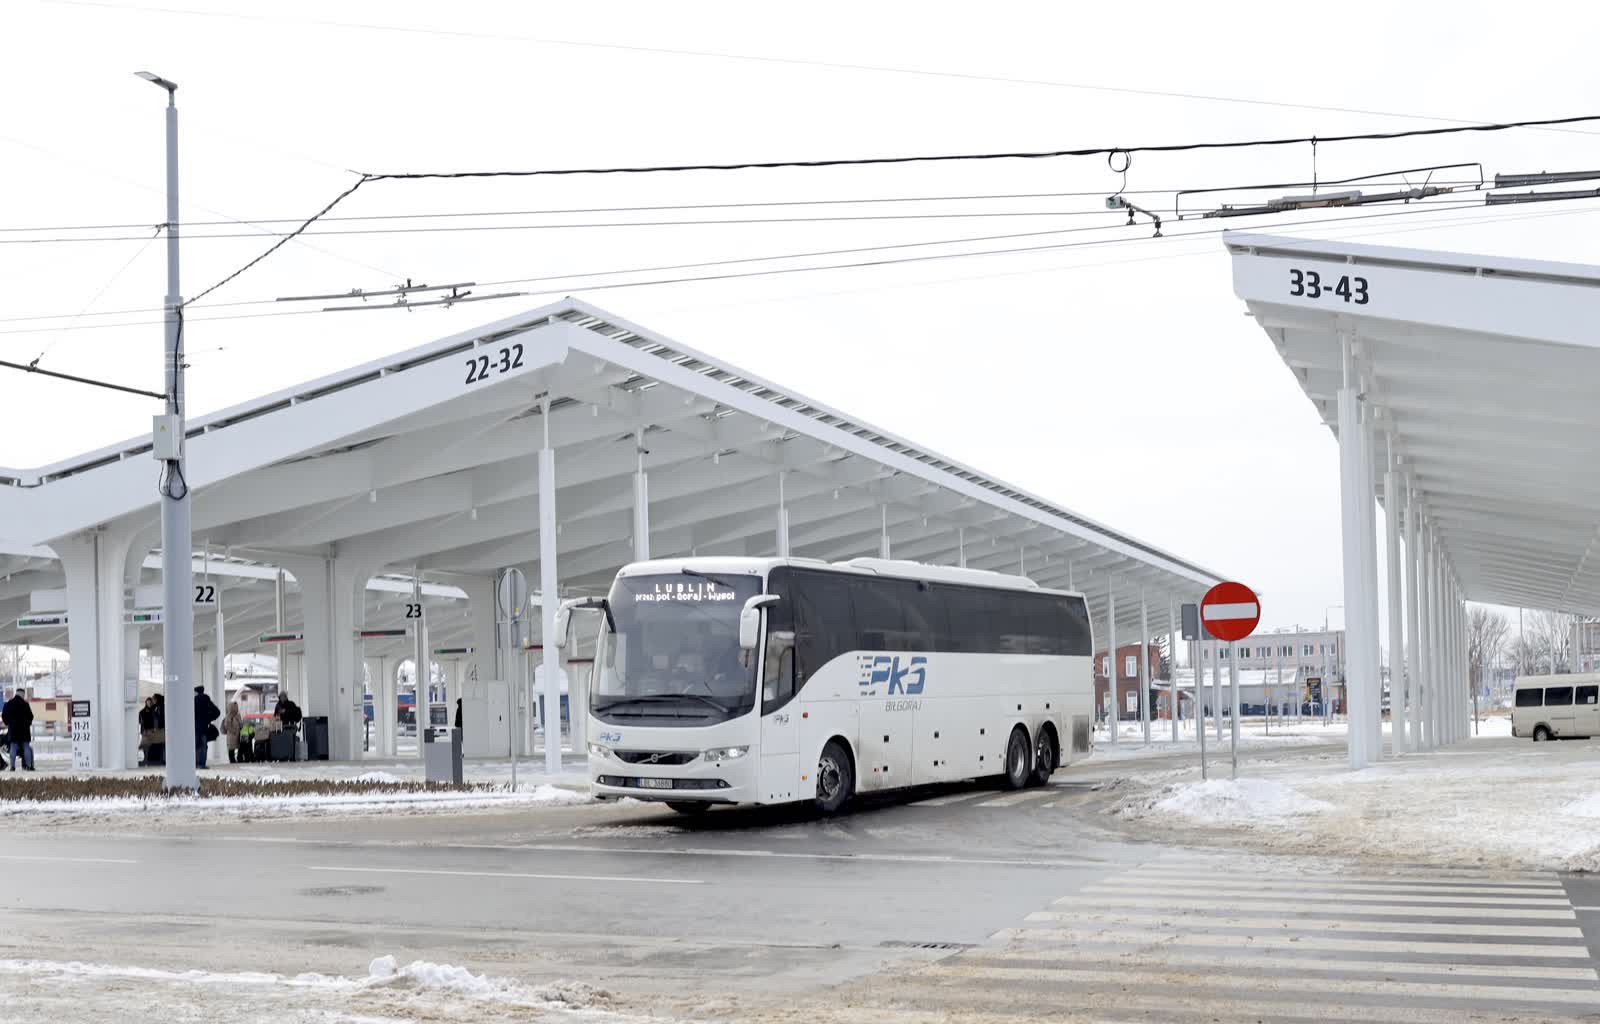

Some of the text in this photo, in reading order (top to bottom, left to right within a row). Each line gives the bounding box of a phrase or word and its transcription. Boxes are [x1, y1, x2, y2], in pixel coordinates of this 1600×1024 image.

[1290, 269, 1369, 305] 33-43
[465, 343, 523, 384] 22-32
[195, 585, 214, 602] 22
[655, 583, 715, 593] LUBLIN
[406, 604, 422, 618] 23
